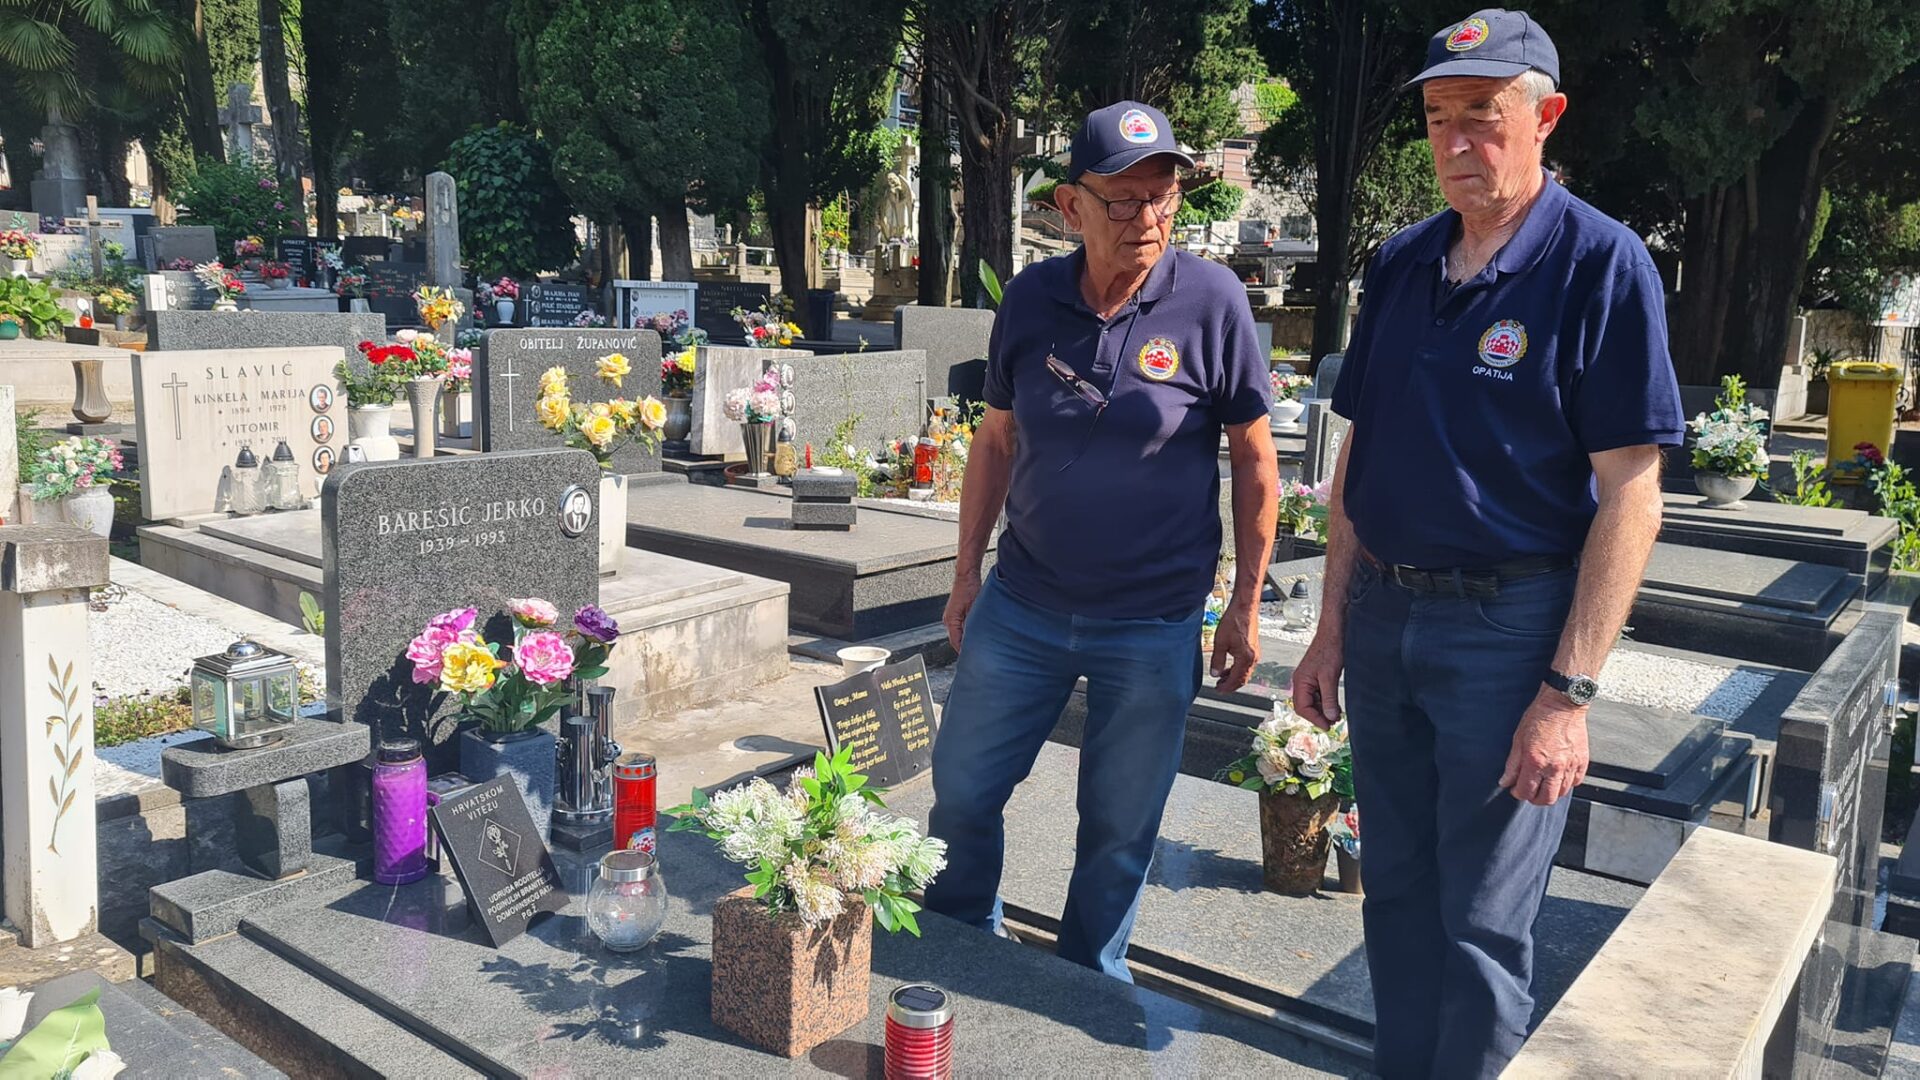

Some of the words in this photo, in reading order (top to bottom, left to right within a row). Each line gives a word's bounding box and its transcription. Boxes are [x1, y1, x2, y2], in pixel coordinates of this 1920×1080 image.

[519, 337, 564, 350] OBITELJ
[576, 335, 638, 350] ŽUPANOVIĆ
[206, 361, 294, 380] SLAVIĆ
[1472, 365, 1513, 382] OPATIJA
[194, 391, 249, 405] KINKELA
[261, 388, 306, 401] MARIJA
[227, 422, 279, 434] VITOMIR
[378, 498, 473, 535] BAREŠIĆ
[481, 497, 545, 522] JERKO
[419, 536, 454, 555] 1939
[474, 530, 506, 547] 1993
[451, 784, 504, 816] HRVATSKOM
[467, 800, 499, 821] VITEZU
[487, 882, 514, 904] UDRUGA
[513, 867, 545, 889] RODITELJA
[487, 891, 521, 916] POGINULIH
[495, 893, 541, 923] DOMOVINSKOG
[539, 885, 555, 899] RATA
